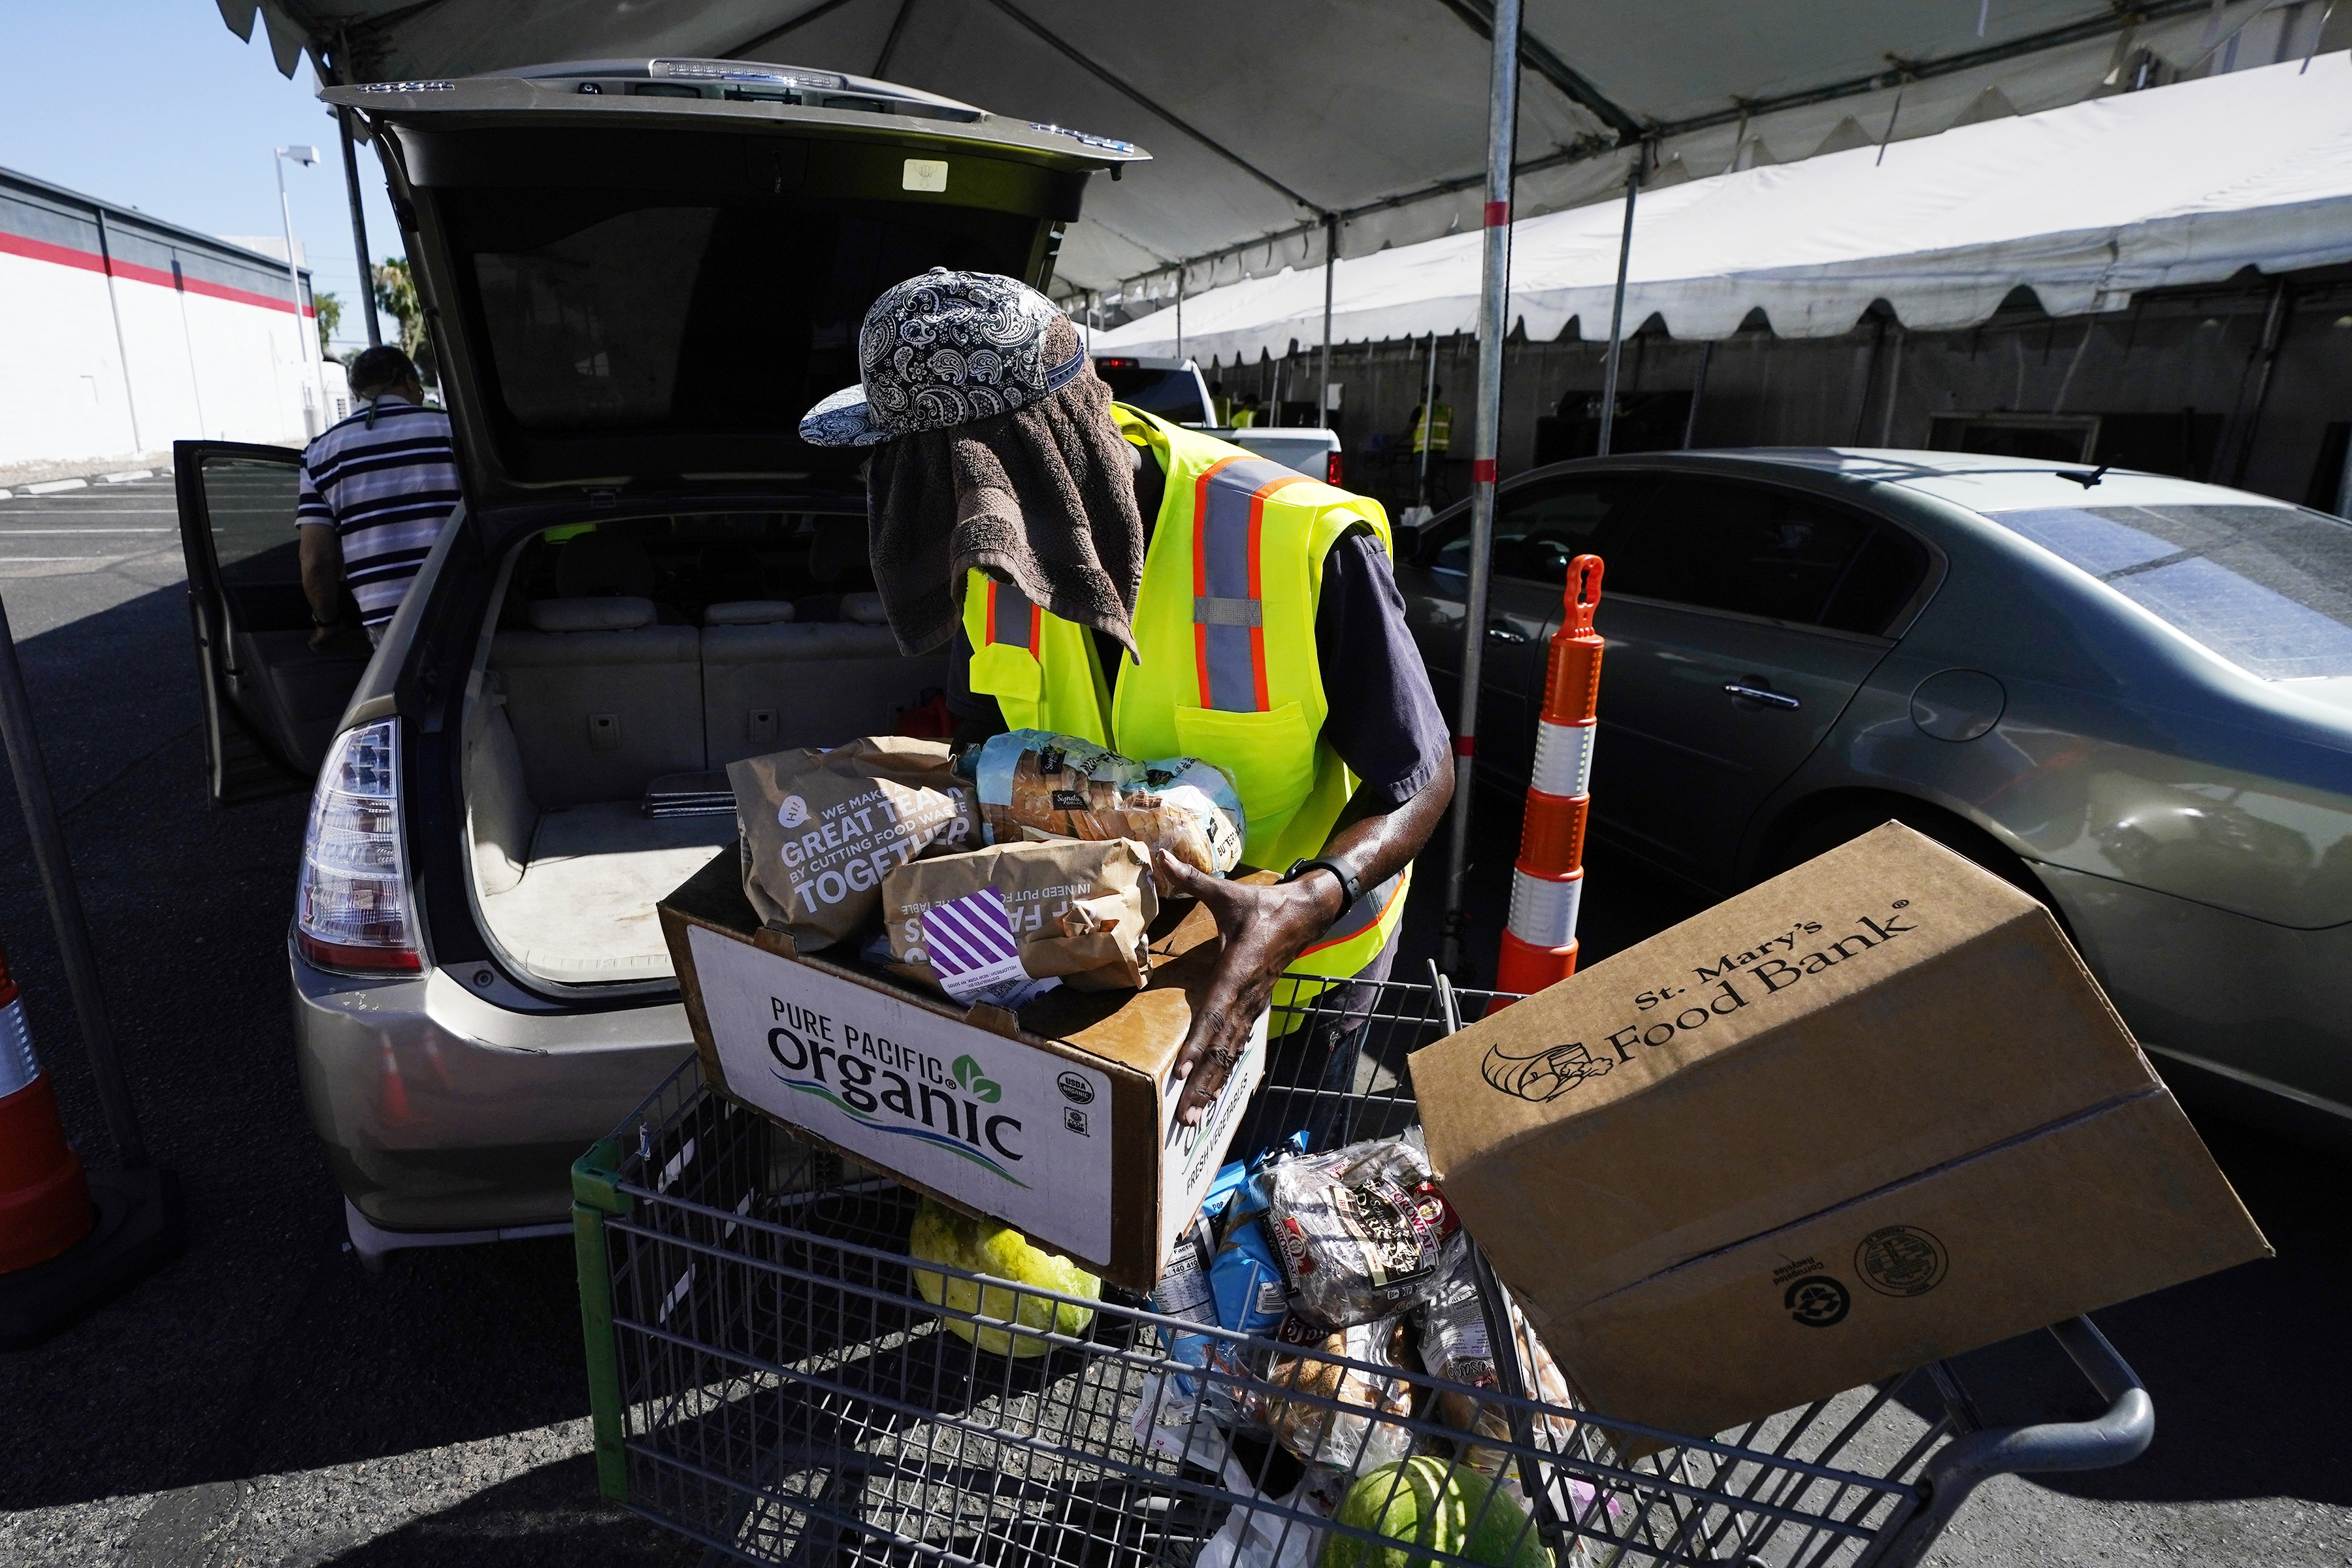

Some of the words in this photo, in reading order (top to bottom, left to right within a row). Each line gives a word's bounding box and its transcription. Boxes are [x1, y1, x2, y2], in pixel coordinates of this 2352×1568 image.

[786, 802, 802, 822] HI!
[821, 804, 847, 820] WE
[849, 788, 890, 809] MAKE
[781, 808, 874, 868] GREAT
[789, 866, 806, 884] BY
[809, 838, 872, 872] CUTTING
[874, 820, 916, 844] FOOD
[919, 802, 968, 825] WASTE
[1015, 887, 1039, 901] PUT
[1043, 884, 1075, 898] NEED
[1077, 883, 1090, 894] IN
[902, 902, 934, 915] TABLE
[990, 965, 1017, 977] HELLOFRESH
[1635, 988, 1686, 1011] St.
[771, 996, 834, 1043] PURE
[1604, 980, 1750, 1065] Food
[1063, 1085, 1088, 1098] ORGANIC
[1065, 1077, 1086, 1090] USDA
[1186, 1149, 1209, 1196] FRESH
[1209, 1072, 1248, 1152] VEGETABLES
[1356, 1192, 1384, 1237] DARK
[1394, 1192, 1435, 1252] OROWEAT
[1173, 1244, 1193, 1254] Facts
[1274, 1223, 1298, 1277] OROWEAT
[1172, 1266, 1184, 1274] 140
[1186, 1260, 1198, 1269] 410
